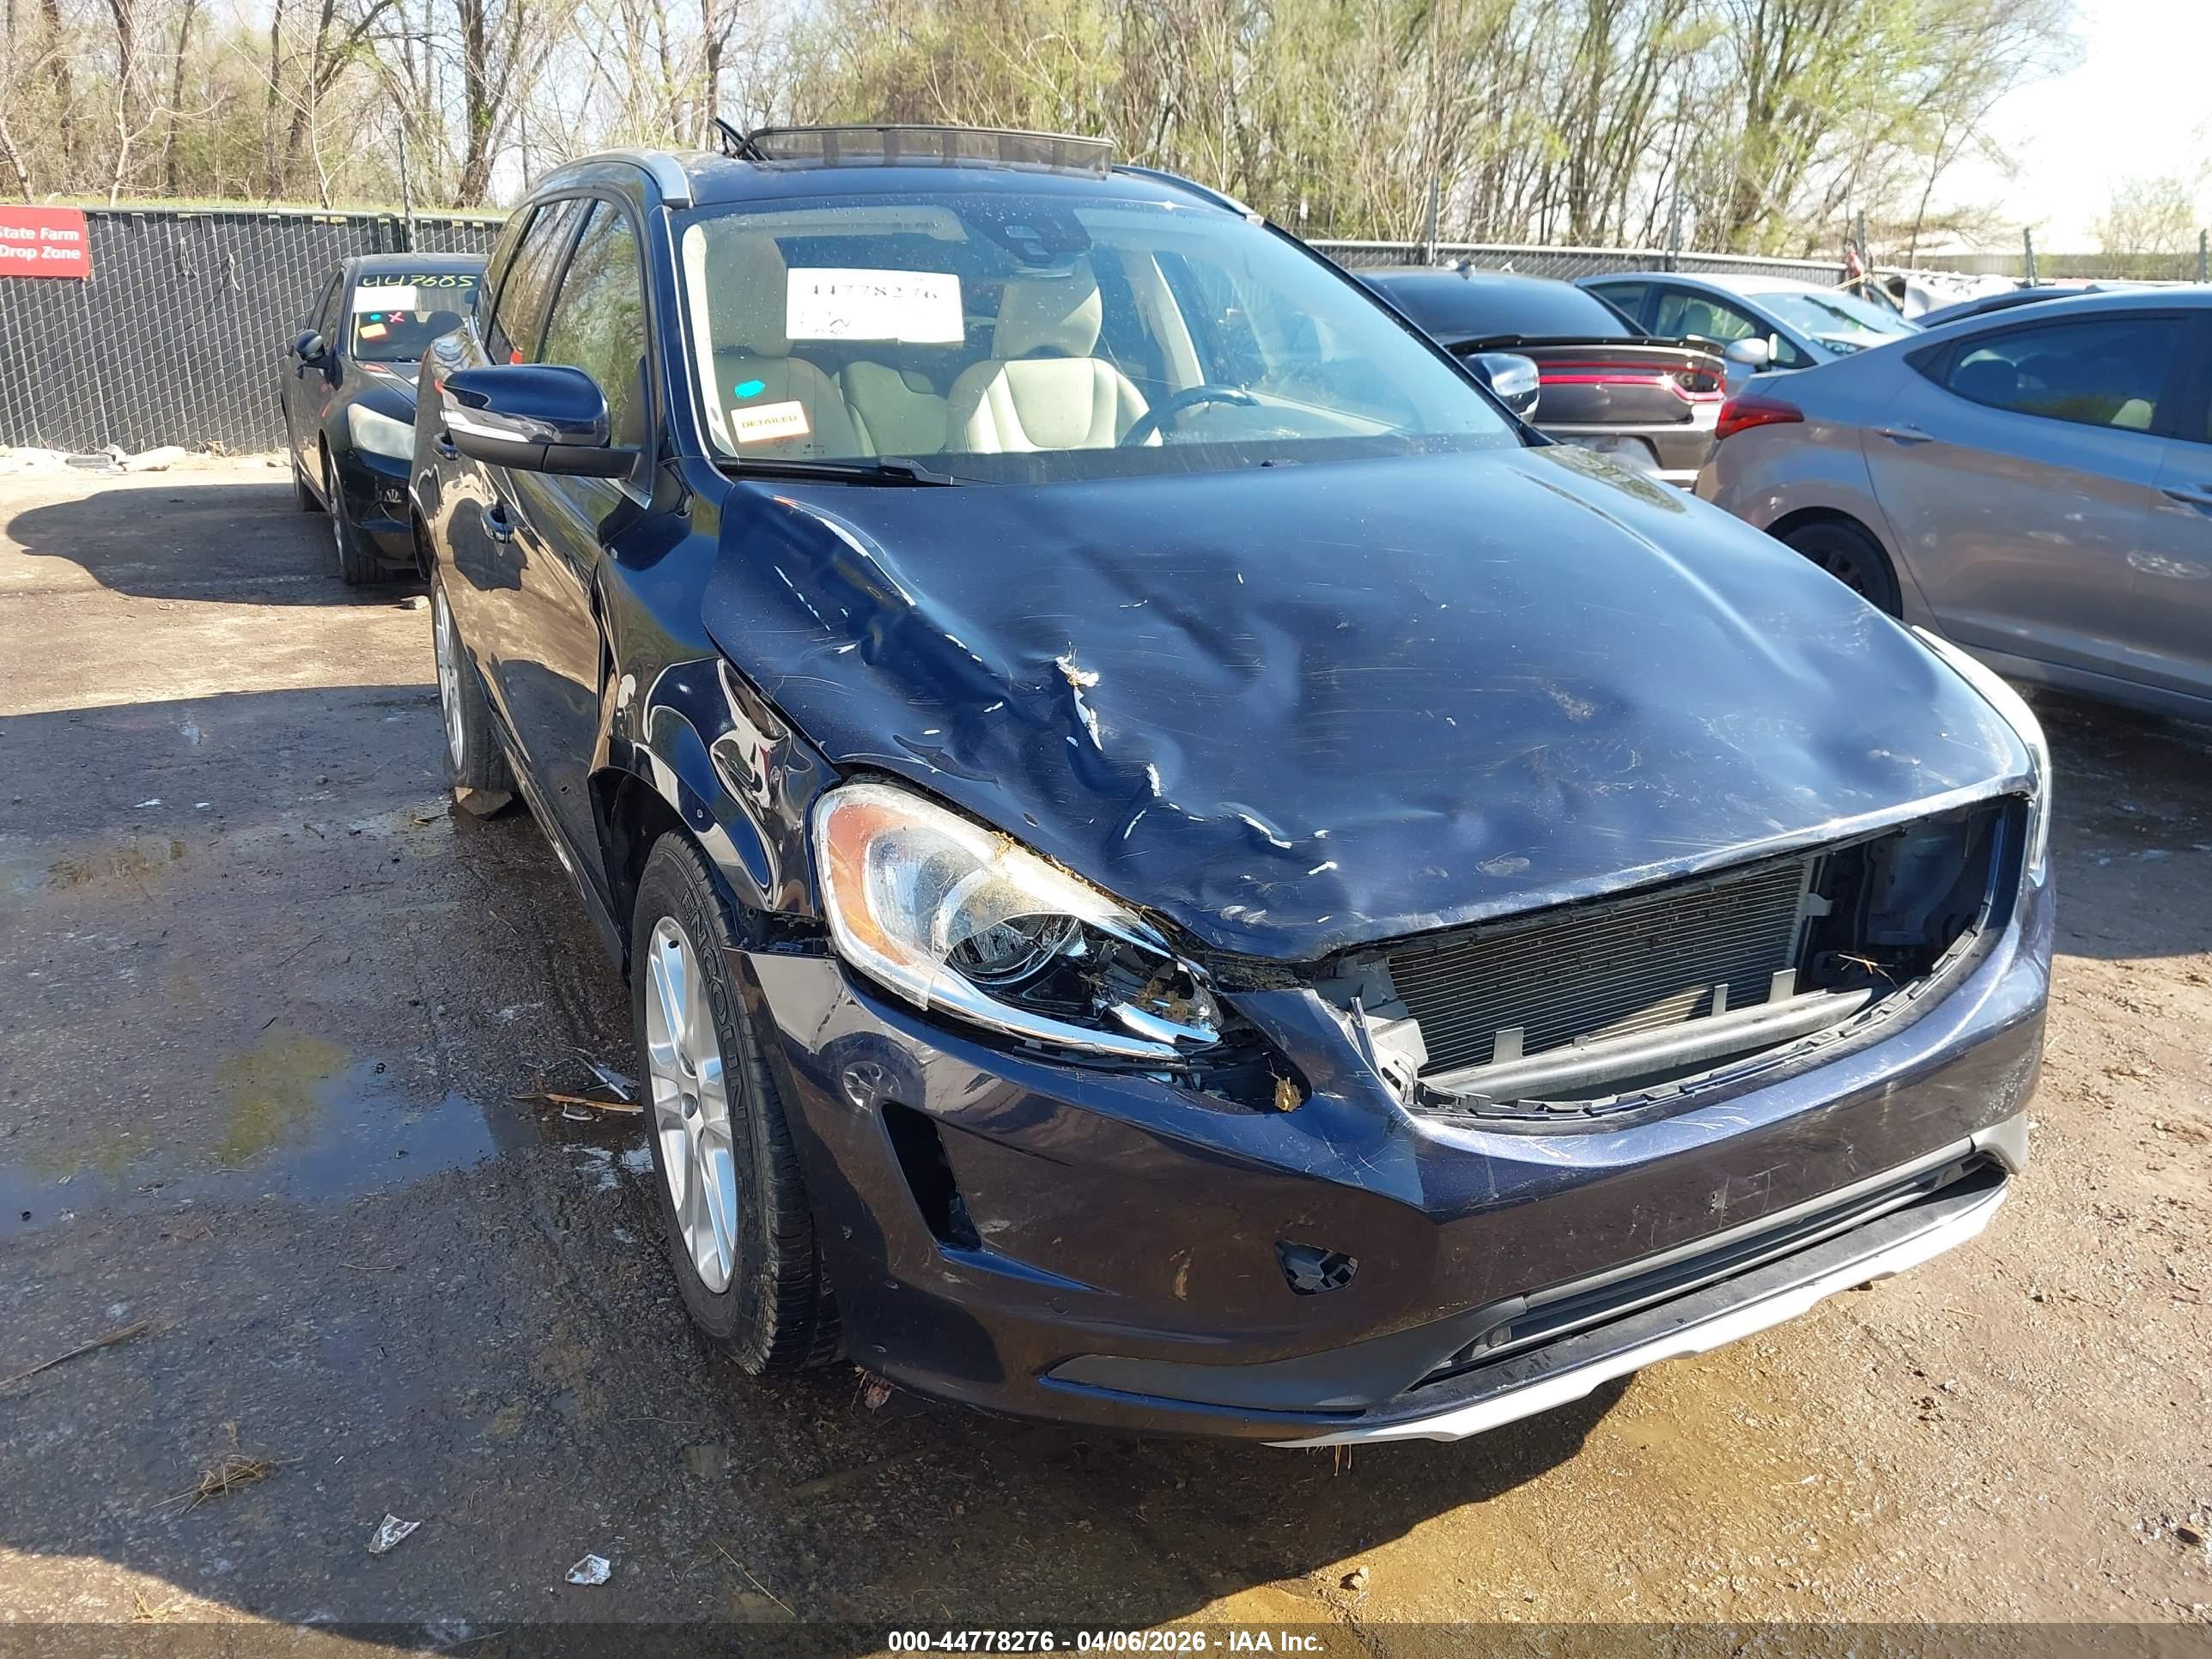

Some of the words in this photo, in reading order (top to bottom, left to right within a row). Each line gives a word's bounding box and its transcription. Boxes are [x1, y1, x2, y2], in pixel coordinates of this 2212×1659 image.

[40, 227, 79, 240] Farm
[0, 244, 38, 261] Drop
[40, 246, 81, 259] Zone
[741, 415, 798, 428] DETAILED
